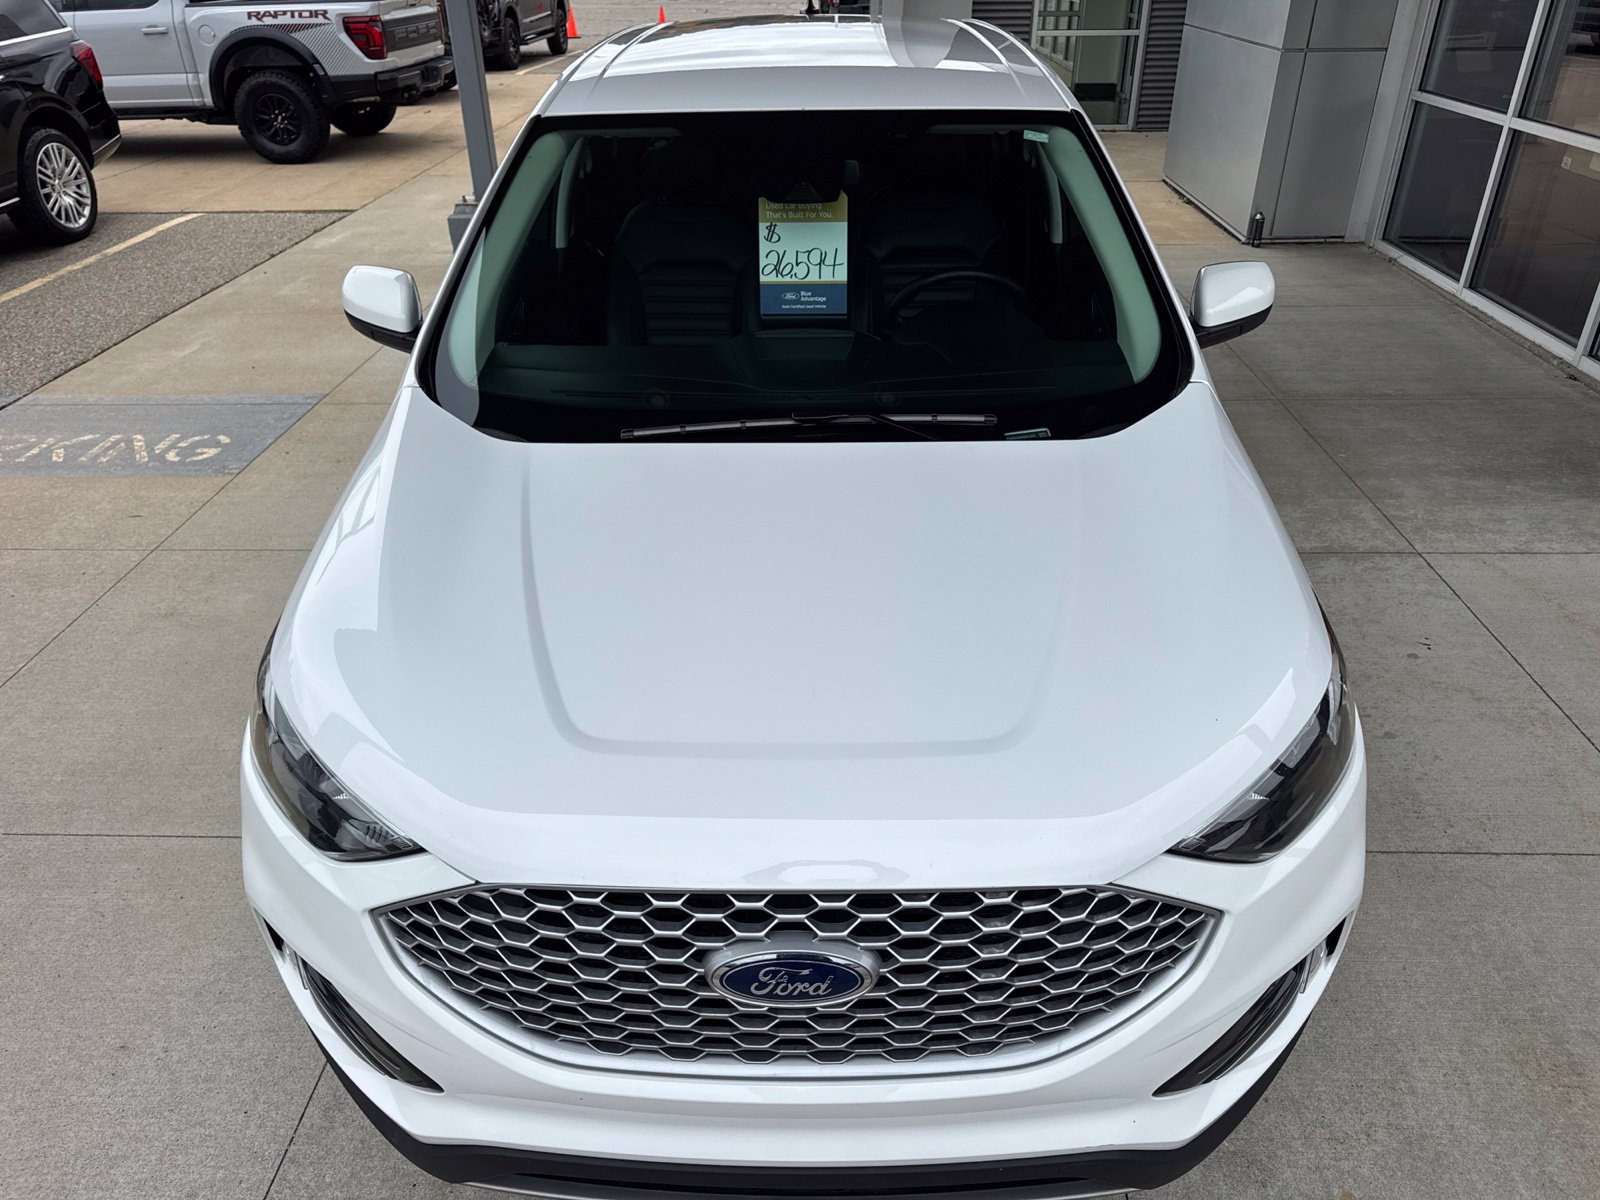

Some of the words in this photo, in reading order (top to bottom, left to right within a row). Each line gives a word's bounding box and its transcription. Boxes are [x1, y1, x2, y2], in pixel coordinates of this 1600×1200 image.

[247, 9, 332, 23] RAPTOR
[766, 211, 787, 219] That's
[788, 211, 805, 219] Built
[763, 222, 781, 243] $
[761, 247, 845, 280] 26,594
[750, 966, 835, 996] Ford
